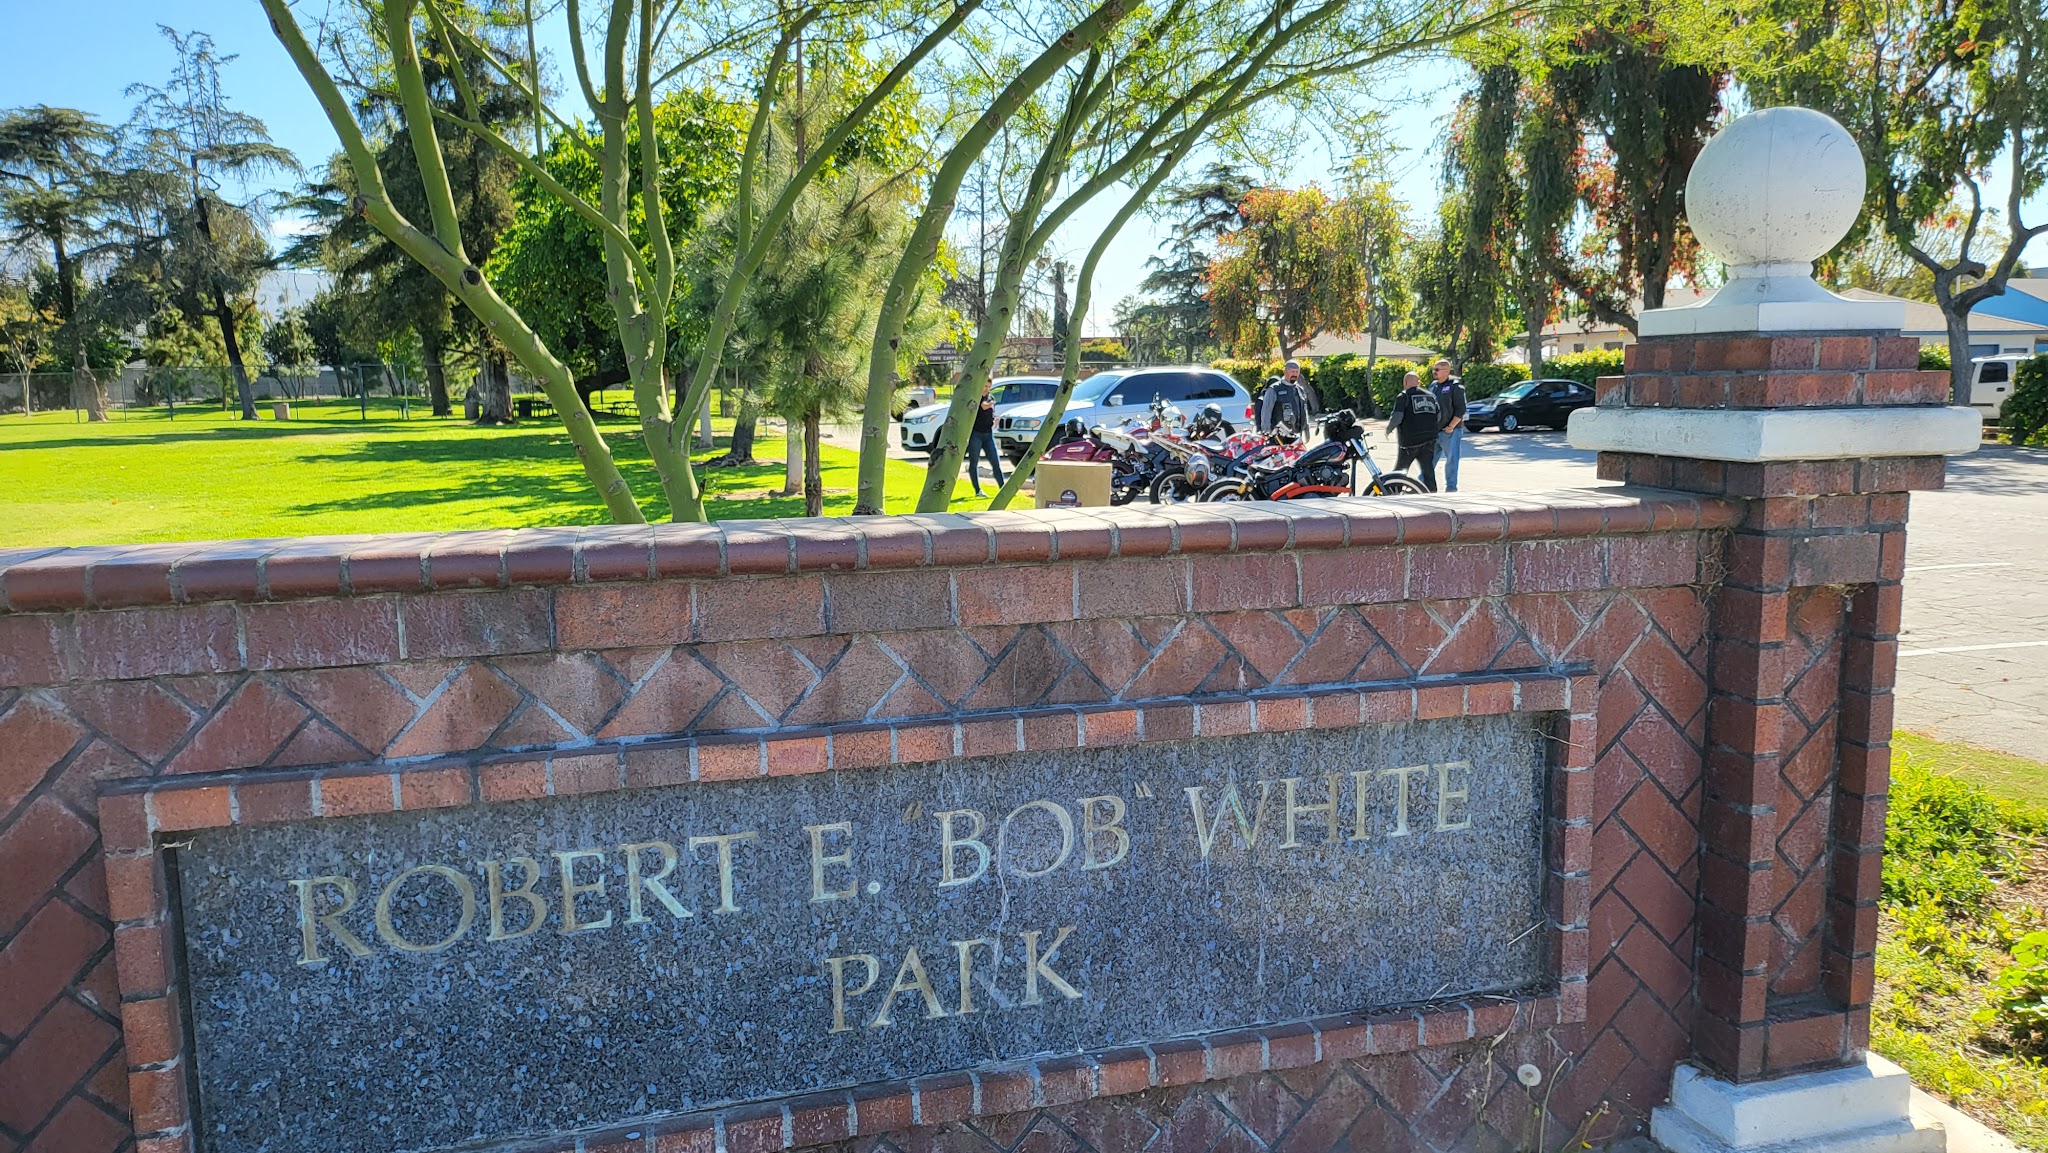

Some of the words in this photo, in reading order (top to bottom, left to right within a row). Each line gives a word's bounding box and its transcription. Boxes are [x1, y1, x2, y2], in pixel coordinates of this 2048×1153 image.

[288, 831, 758, 966] ROBERT
[802, 820, 881, 903] E.
[1184, 760, 1474, 859] WHITE
[825, 925, 1083, 1035] PARK
